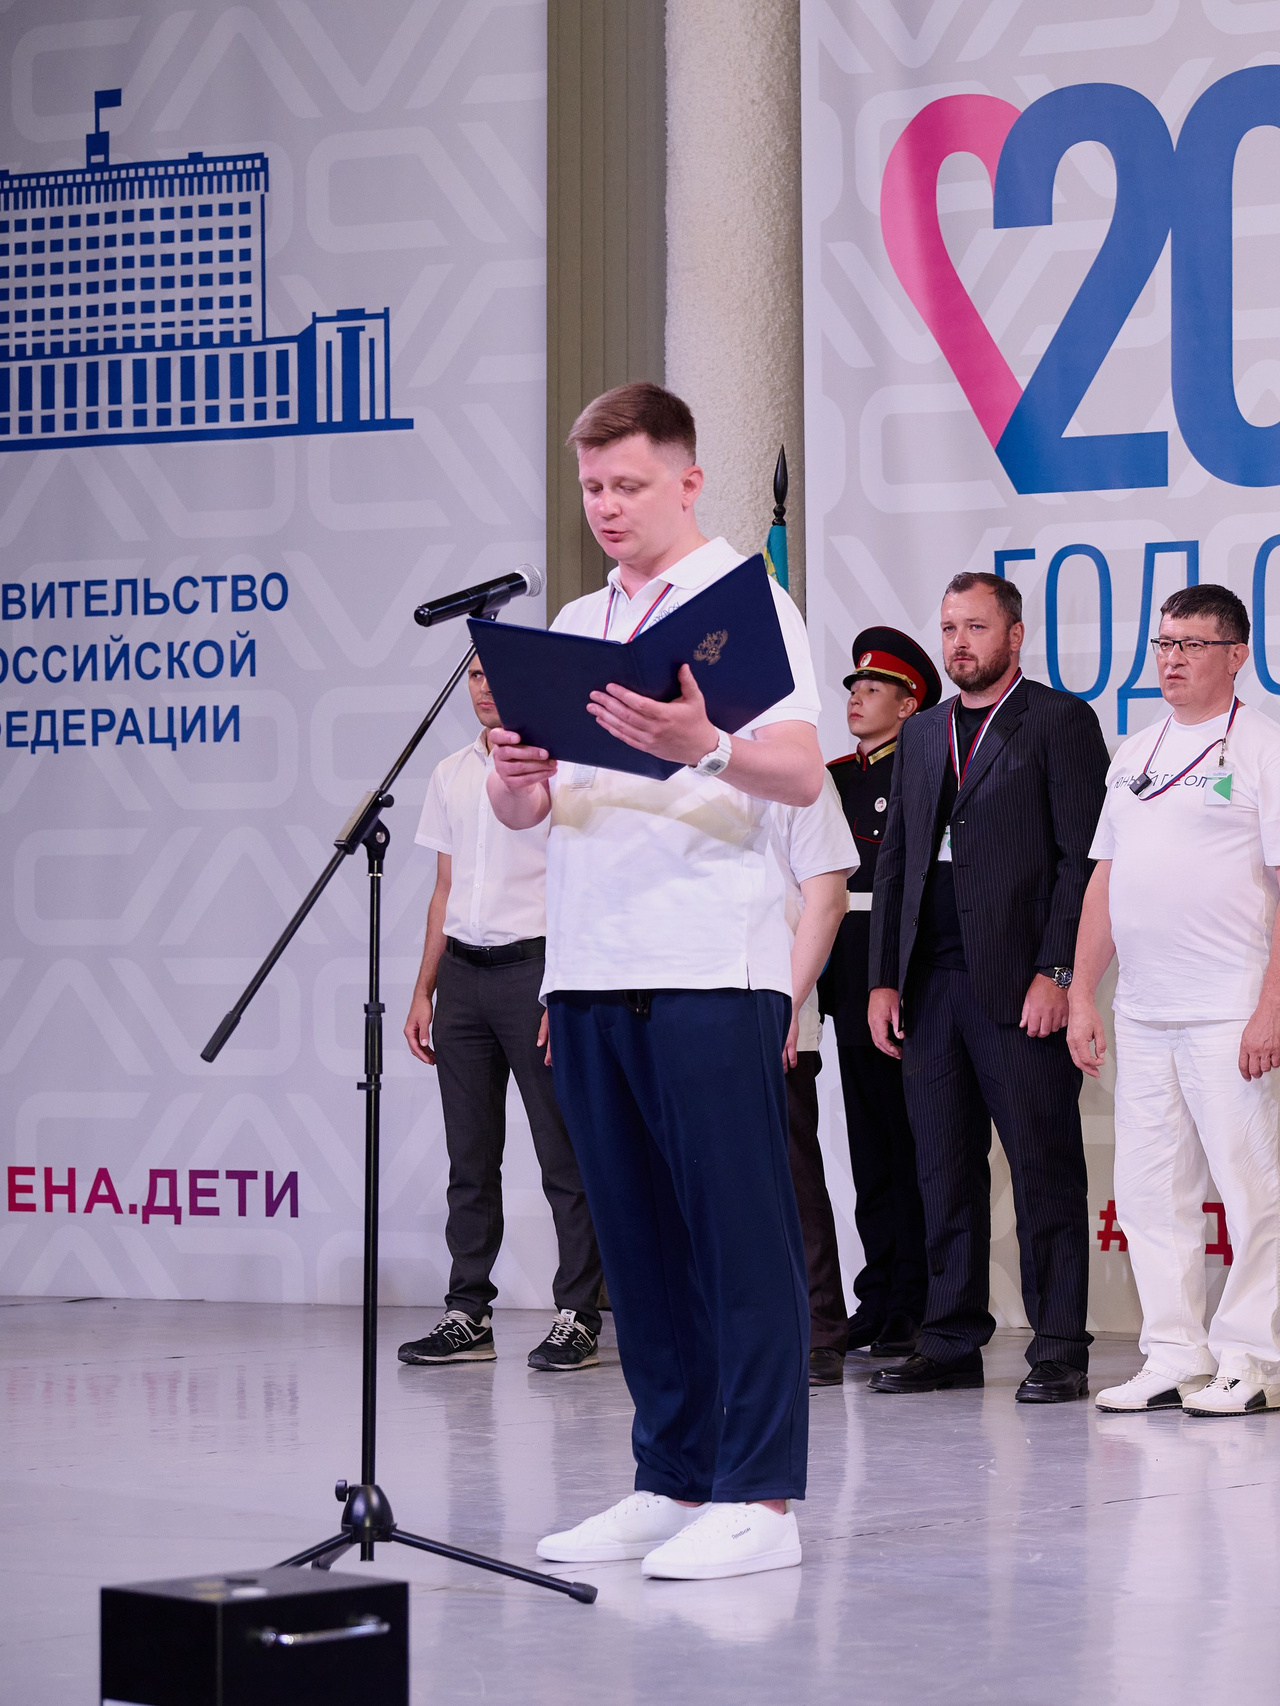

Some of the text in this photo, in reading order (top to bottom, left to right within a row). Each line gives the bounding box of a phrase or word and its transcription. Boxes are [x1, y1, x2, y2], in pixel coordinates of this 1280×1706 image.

[2, 572, 289, 620] ВИТЕЛЬСТВО
[0, 630, 256, 684] ССИЙСКОЙ
[0, 704, 240, 755] ЕДЕРАЦИИ
[7, 1166, 299, 1225] ЕНА.ДЕТИ
